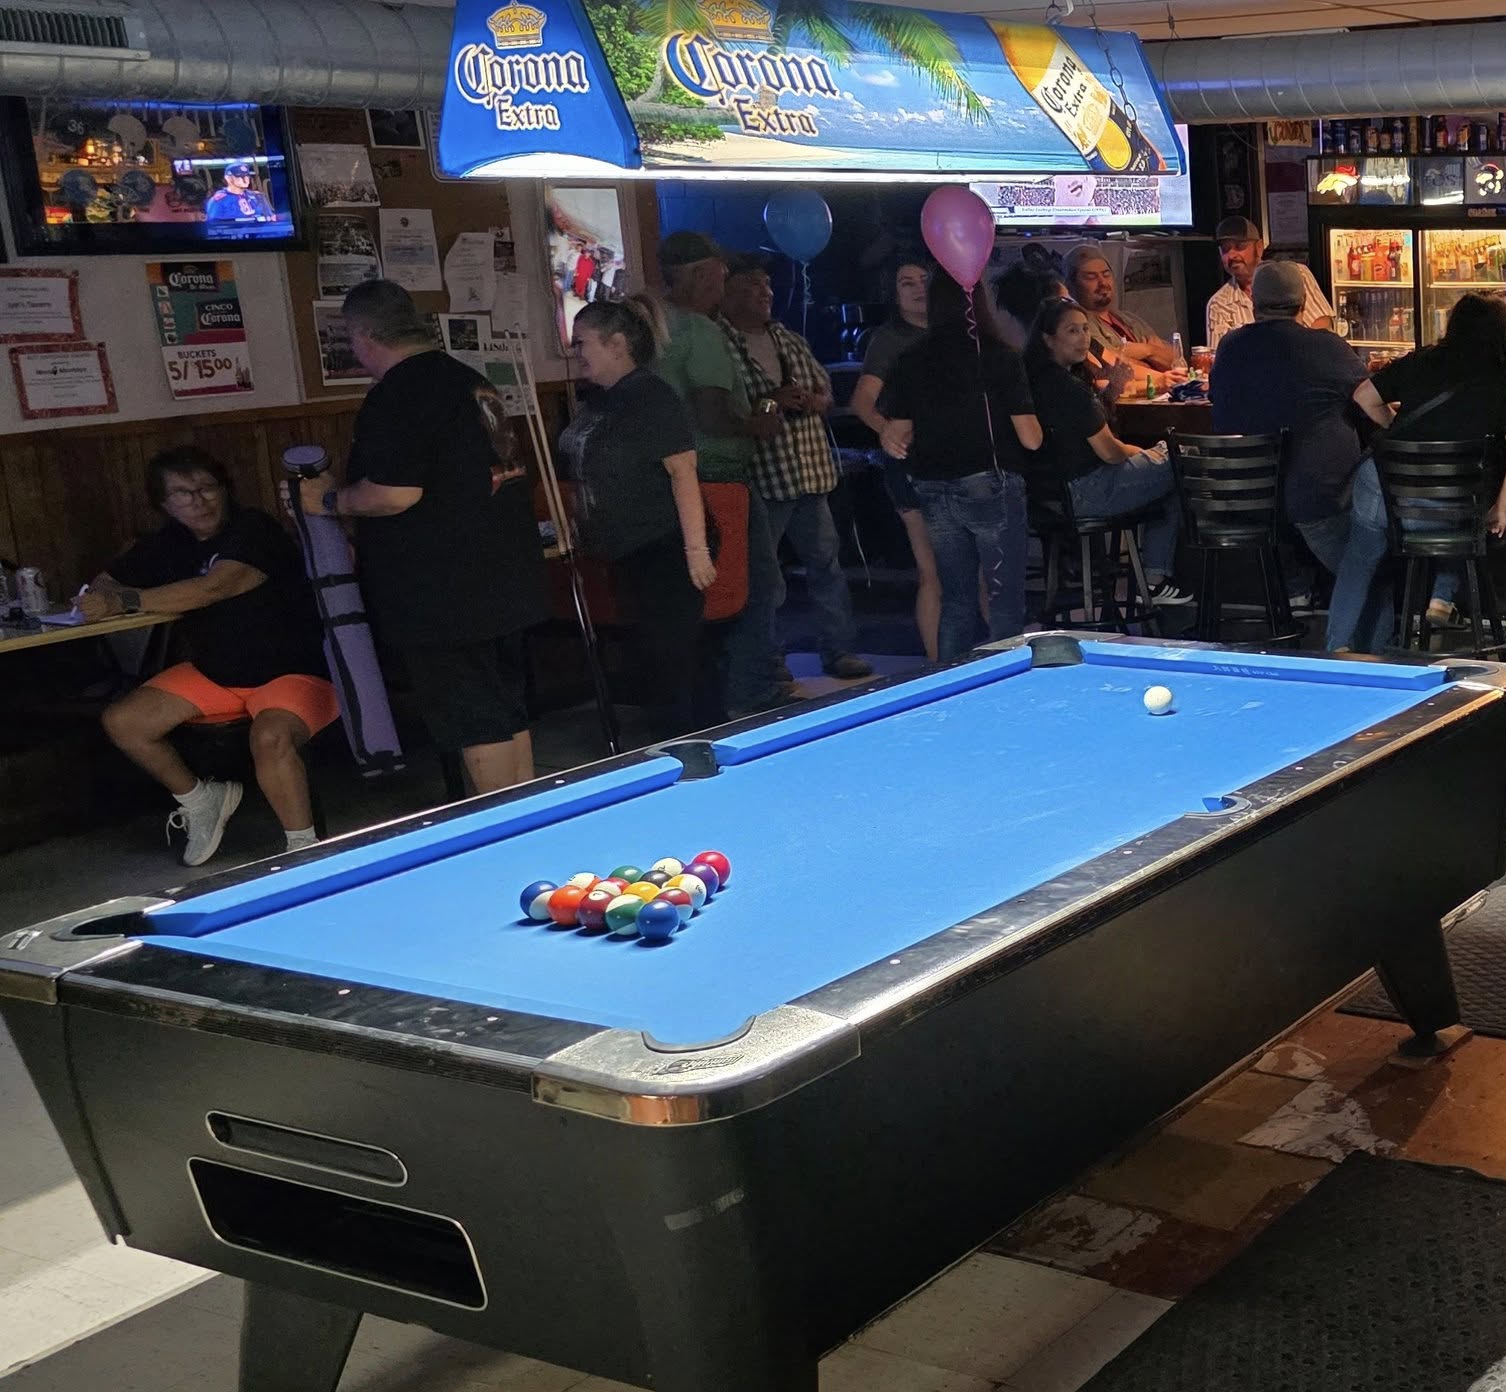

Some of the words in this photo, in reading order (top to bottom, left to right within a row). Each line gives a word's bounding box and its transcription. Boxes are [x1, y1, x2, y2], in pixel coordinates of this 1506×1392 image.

[455, 43, 590, 106] Corona
[664, 30, 840, 103] Corona
[1041, 56, 1079, 114] Corona
[1064, 82, 1087, 118] Extra
[495, 95, 561, 131] Extra
[732, 97, 821, 137] Extra
[169, 272, 214, 288] Corona
[200, 311, 241, 326] Corona
[204, 303, 234, 311] CINCO
[177, 349, 217, 360] BUCKETS
